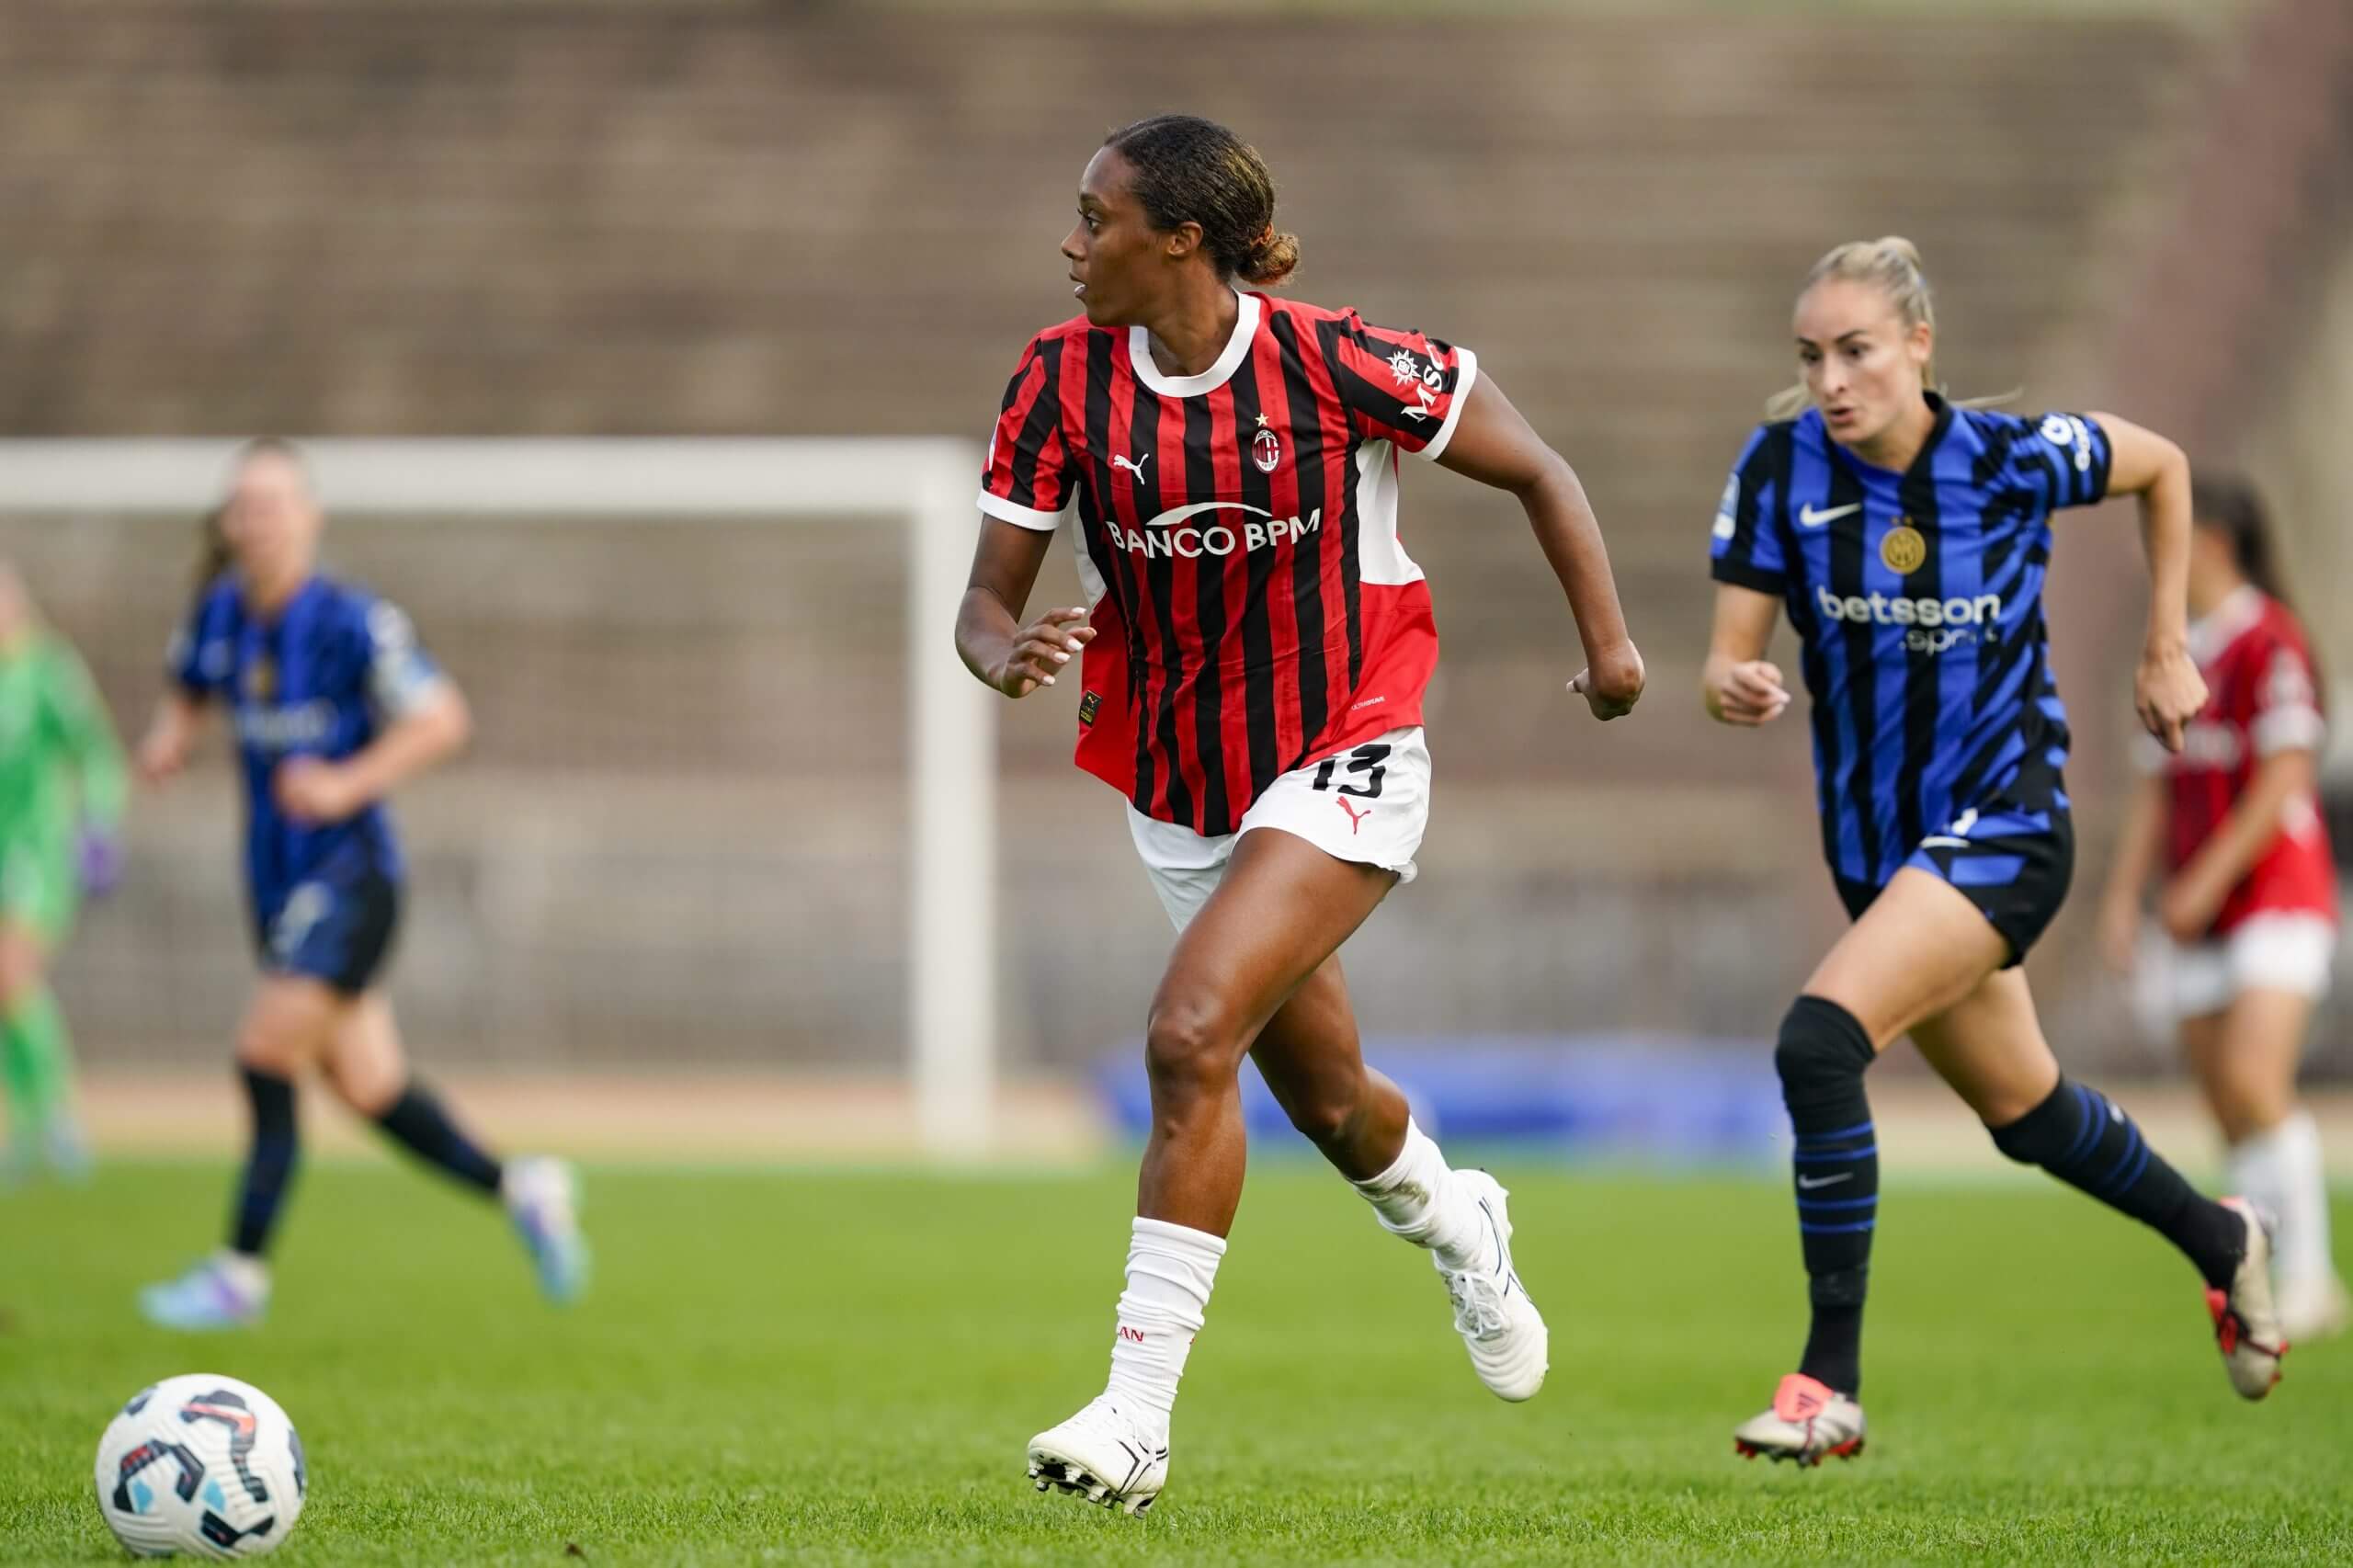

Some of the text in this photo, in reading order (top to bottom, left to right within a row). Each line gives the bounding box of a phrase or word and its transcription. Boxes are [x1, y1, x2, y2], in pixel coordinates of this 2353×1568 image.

[1400, 344, 1445, 424] MSC
[1105, 507, 1321, 559] BANCO BPM
[1816, 585, 2001, 627] betsson
[1313, 744, 1392, 799] 13
[1118, 1325, 1144, 1342] AN
